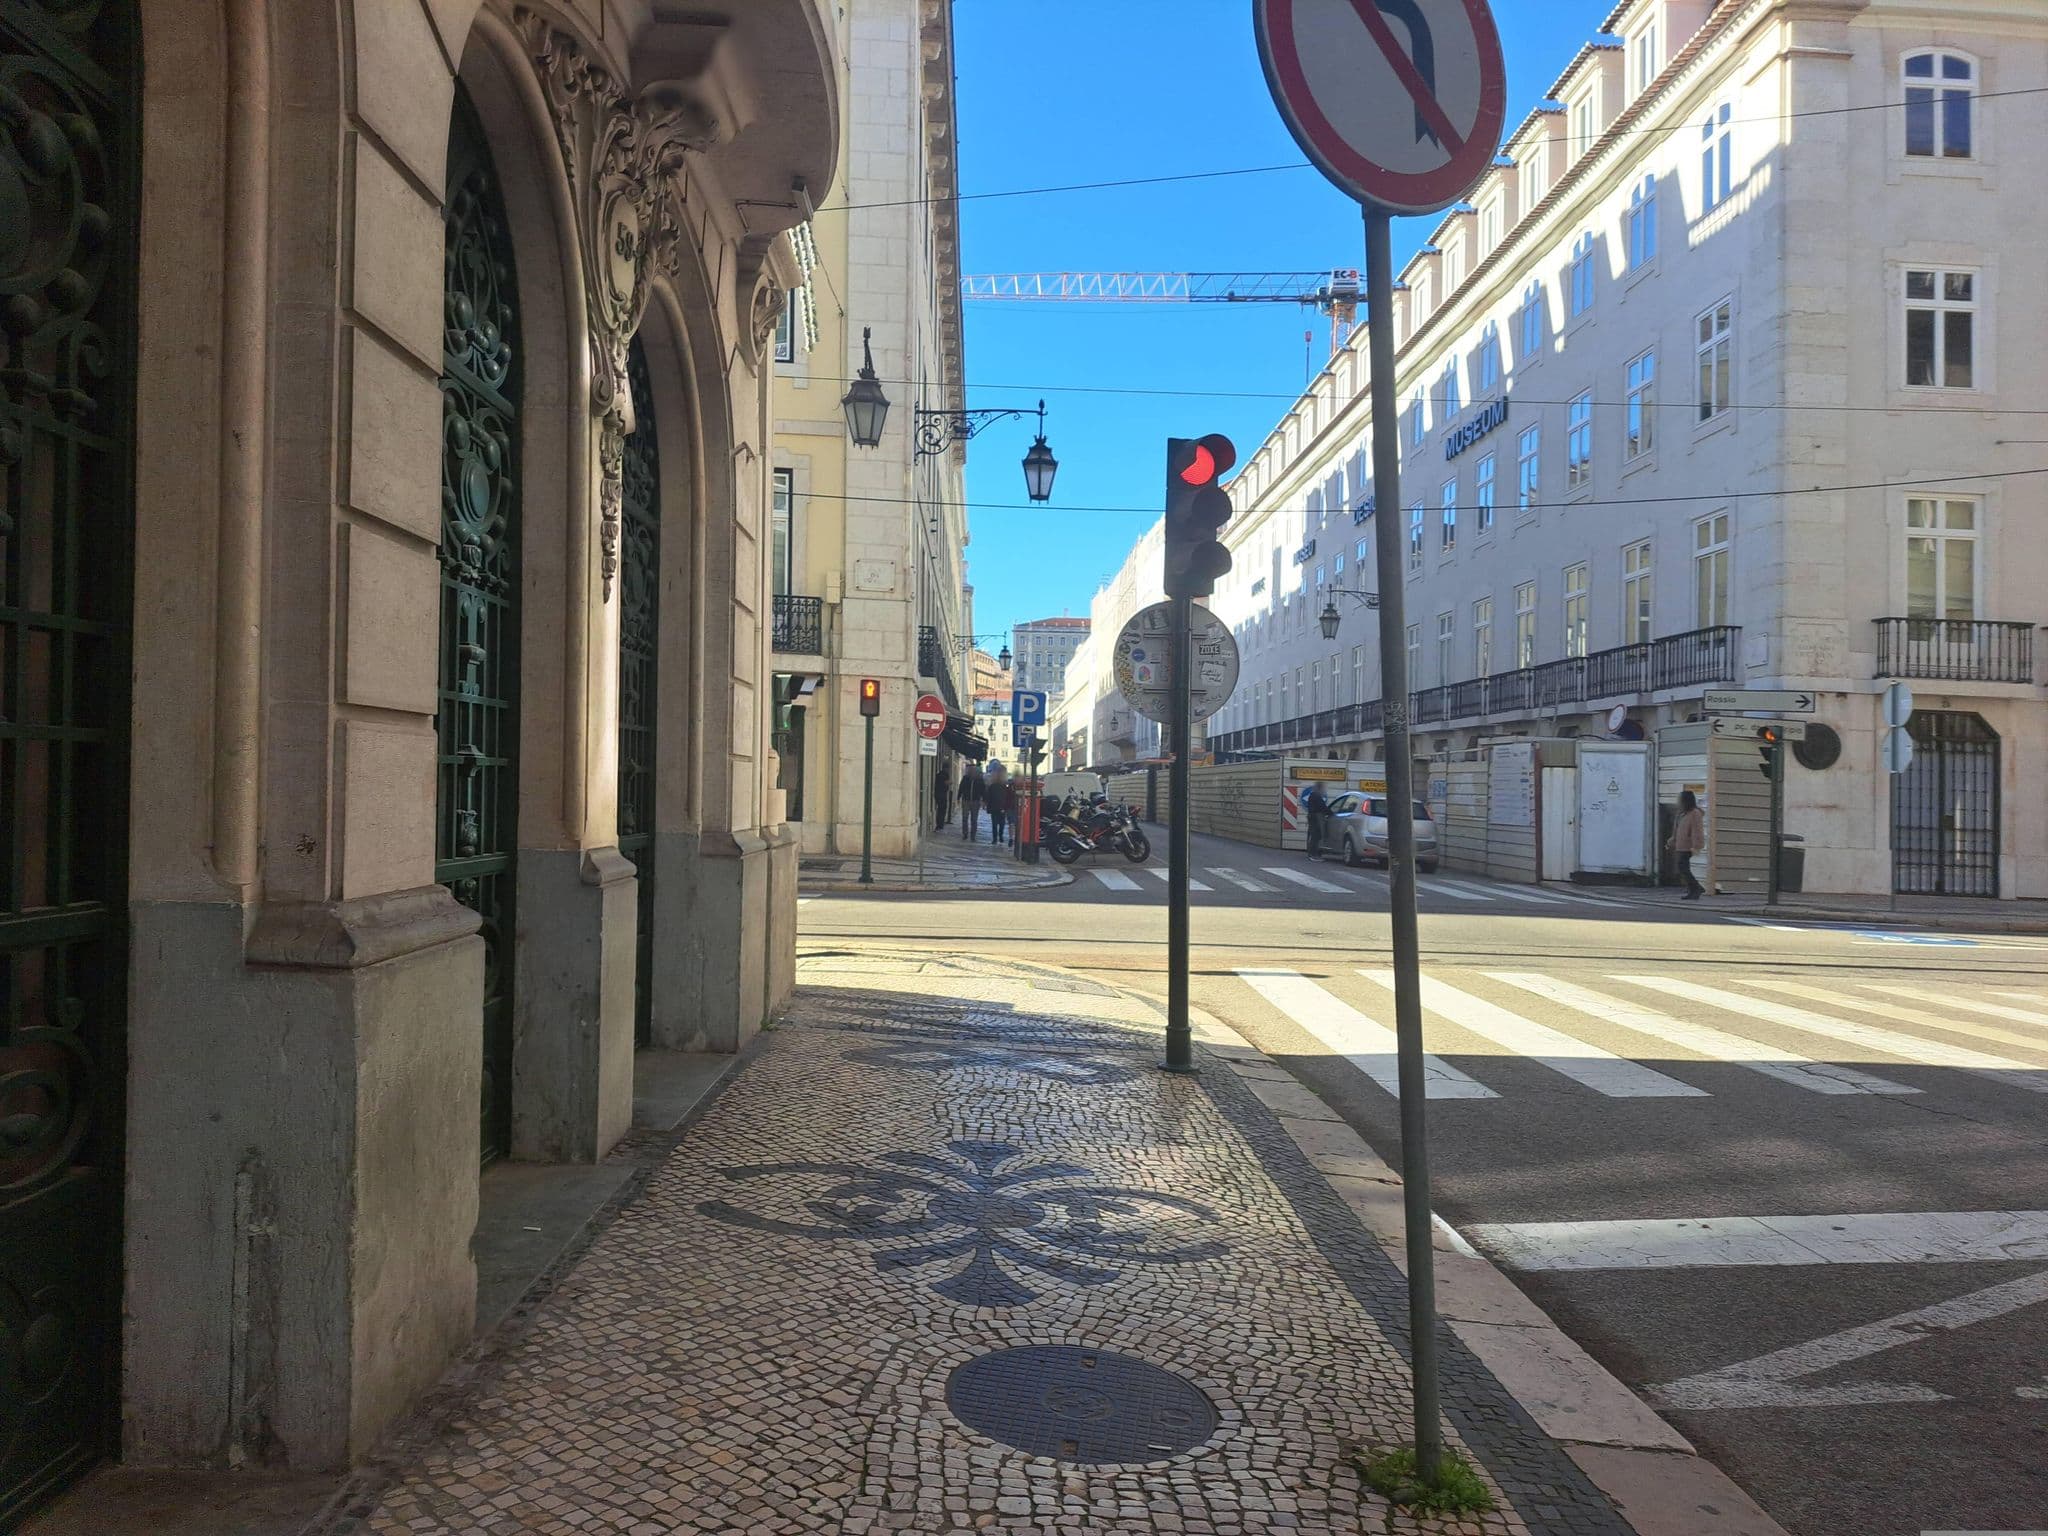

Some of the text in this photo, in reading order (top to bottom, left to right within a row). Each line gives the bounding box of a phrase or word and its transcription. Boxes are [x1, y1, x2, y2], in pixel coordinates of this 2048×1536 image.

[1445, 396, 1508, 461] MUSEUM
[1018, 694, 1040, 722] P
[1707, 695, 1737, 704] Rossio
